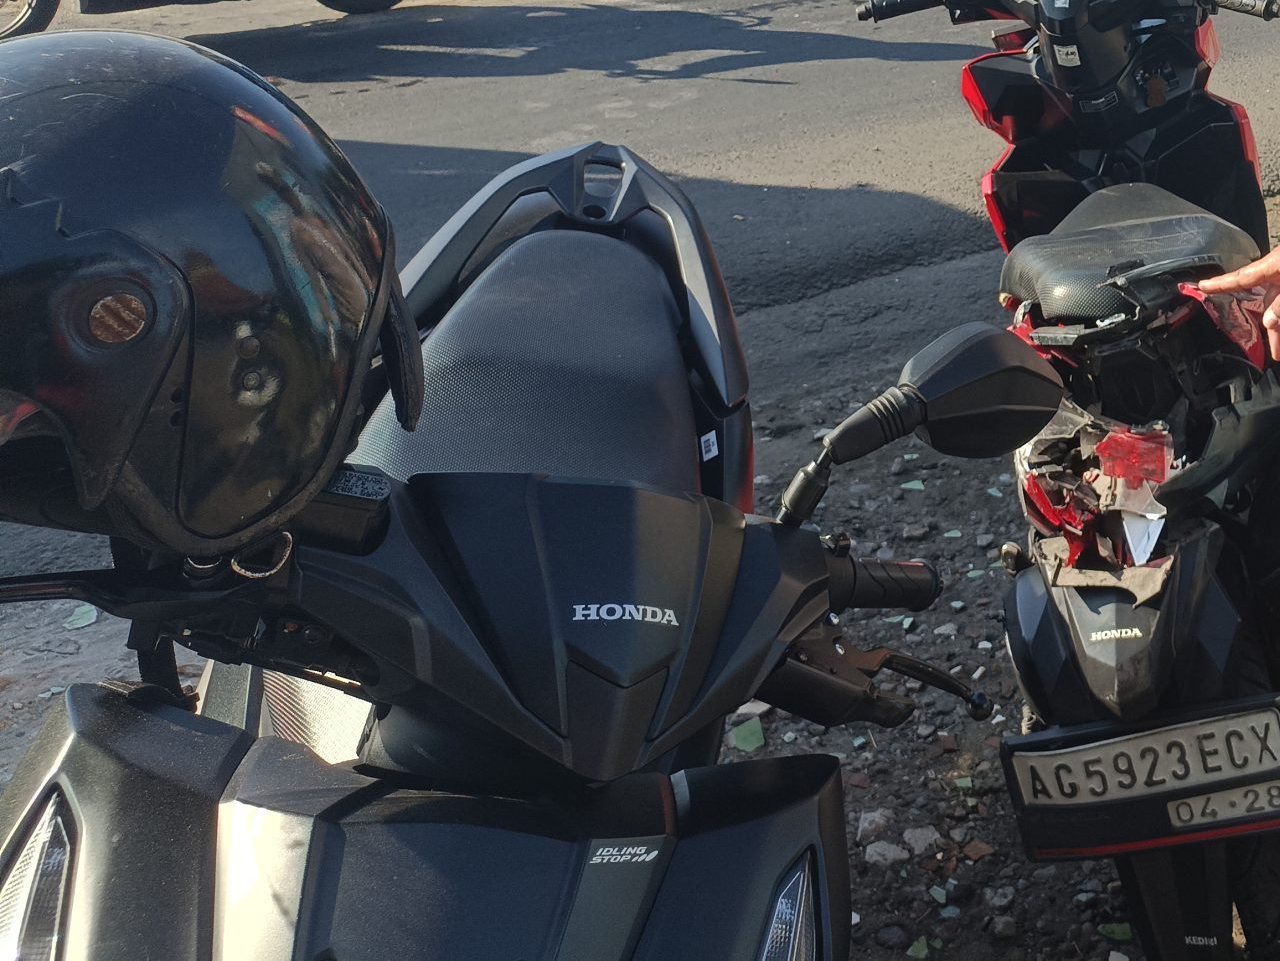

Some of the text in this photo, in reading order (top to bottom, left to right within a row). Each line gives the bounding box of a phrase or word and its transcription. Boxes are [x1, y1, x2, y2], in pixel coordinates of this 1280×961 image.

[572, 603, 680, 626] HONDA
[1089, 628, 1143, 641] HONDA
[595, 846, 648, 856] IDLING
[589, 855, 632, 864] STOP
